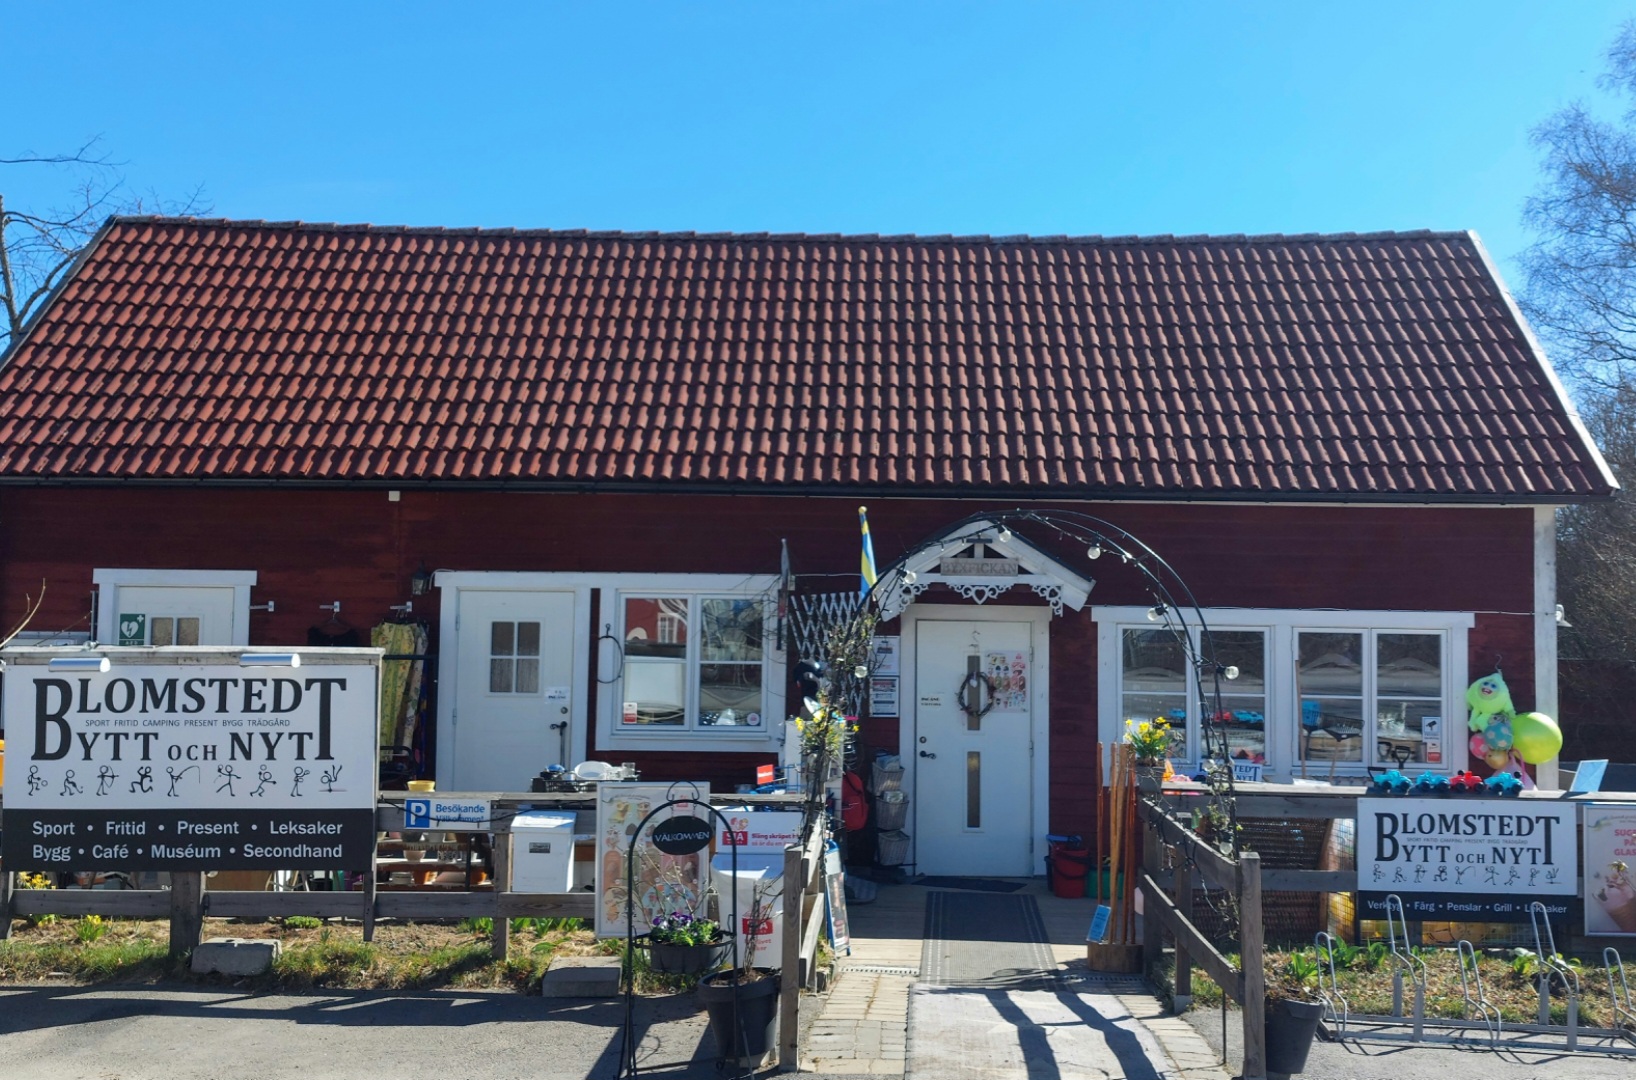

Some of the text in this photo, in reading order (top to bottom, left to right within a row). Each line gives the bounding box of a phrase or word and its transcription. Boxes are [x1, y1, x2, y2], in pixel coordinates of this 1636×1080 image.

[85, 719, 290, 727] SPORT FRITID CAMPING PRESENT BYGG TRÄDGÅRD
[167, 744, 217, 761] OCH
[410, 802, 427, 825] P
[435, 803, 485, 813] Besökande
[32, 820, 343, 837] Sport Fritid Present Leksaker
[654, 831, 710, 842] VÄLKOMMEN
[32, 843, 342, 861] Bygg Café Muséum Secondhand
[1455, 853, 1485, 864] OCH
[1414, 901, 1435, 912] Färg
[1447, 901, 1482, 912] Penslar
[1493, 901, 1512, 912] Grill
[1524, 902, 1567, 913] Lkaker
